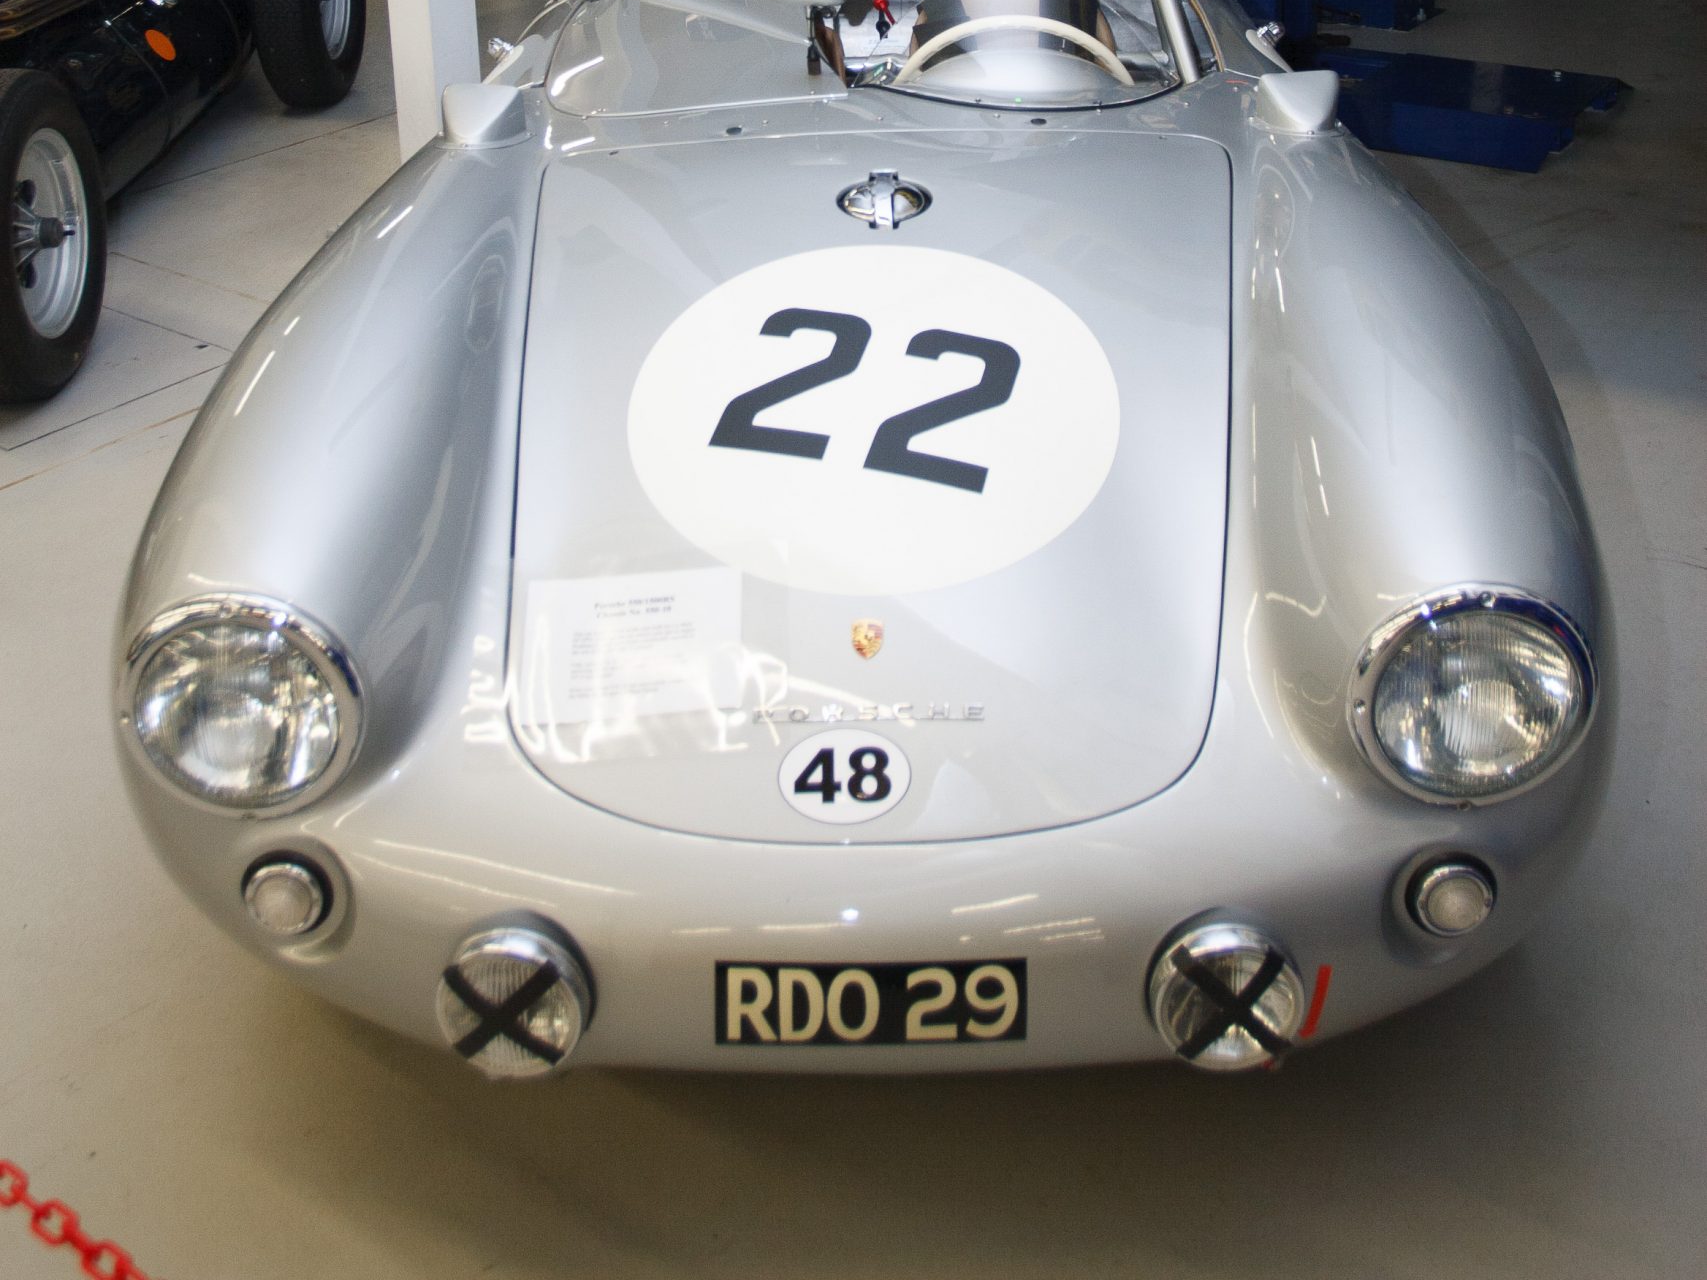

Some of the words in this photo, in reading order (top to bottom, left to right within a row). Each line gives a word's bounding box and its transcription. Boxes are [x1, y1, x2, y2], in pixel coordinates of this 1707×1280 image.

[708, 307, 1021, 494] 22
[753, 701, 985, 723] PORSCHE
[794, 746, 892, 804] 48
[727, 967, 881, 1042] RDO
[906, 965, 1019, 1041] 29
